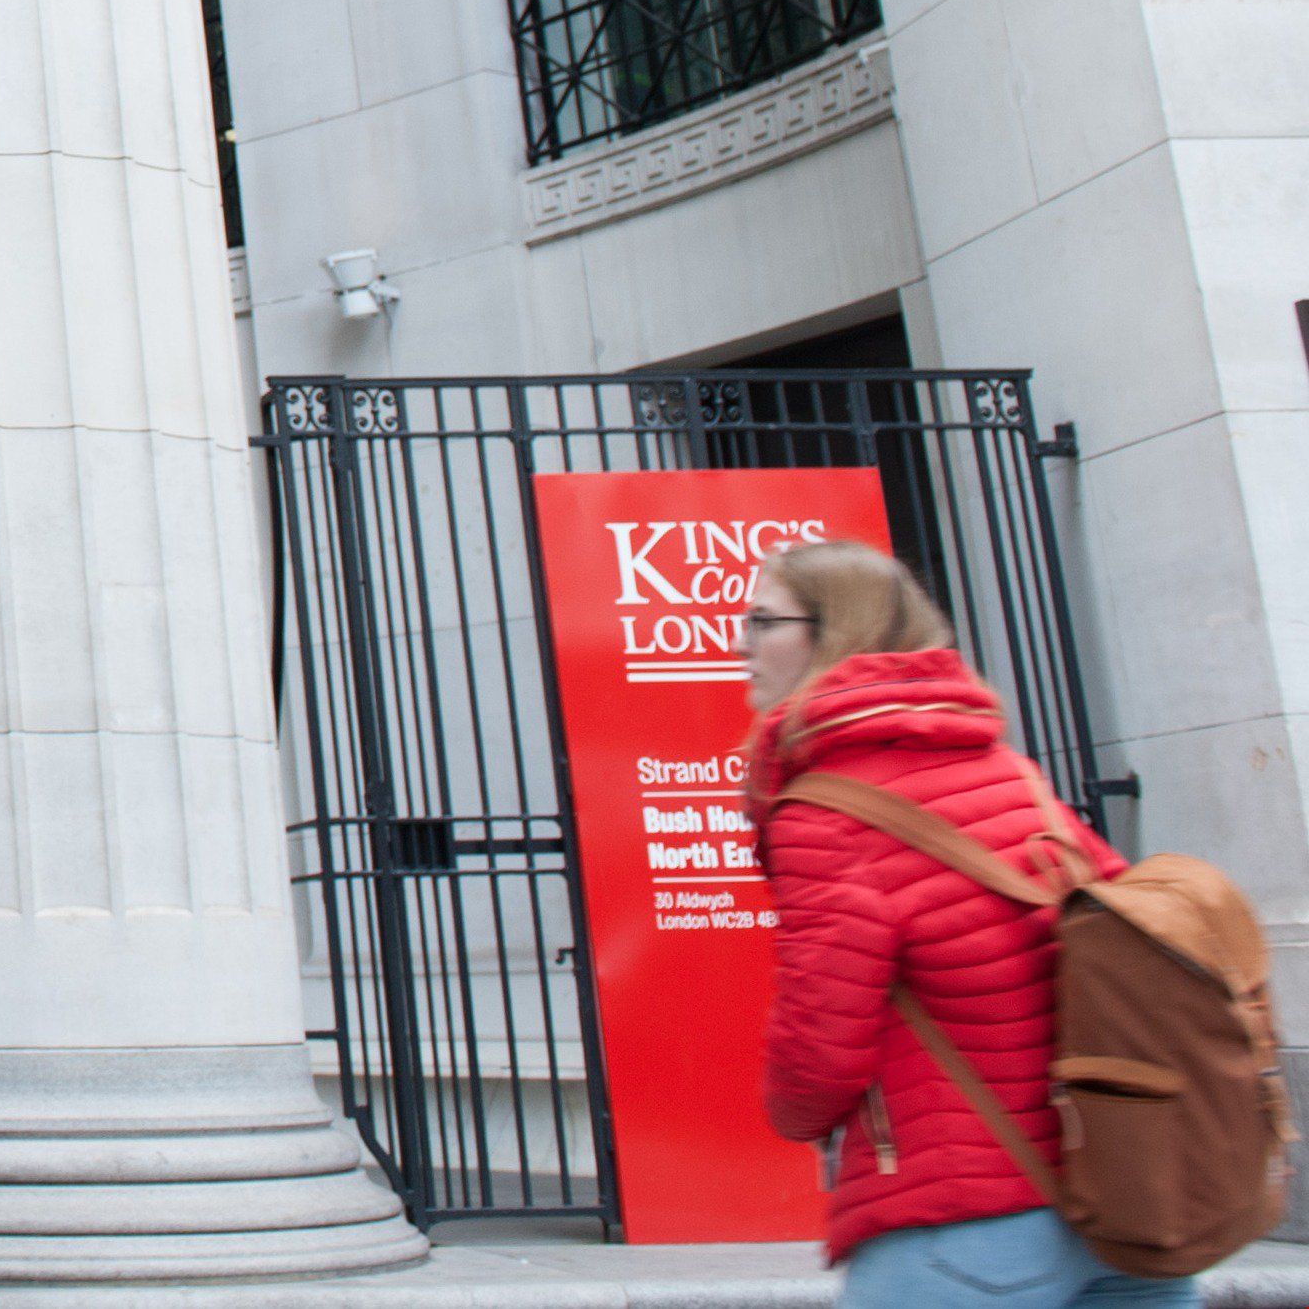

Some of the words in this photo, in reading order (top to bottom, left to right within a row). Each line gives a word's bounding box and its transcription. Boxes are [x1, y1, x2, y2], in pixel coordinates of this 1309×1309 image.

[619, 615, 747, 654] LON
[637, 756, 720, 784] Strand
[642, 805, 703, 833] Bush
[706, 805, 757, 833] Hou
[647, 841, 719, 869] North
[654, 892, 673, 909] 30
[675, 891, 734, 911] Aldwych
[656, 912, 710, 930] London
[711, 911, 755, 929] WC2B
[757, 910, 780, 928] 4B
